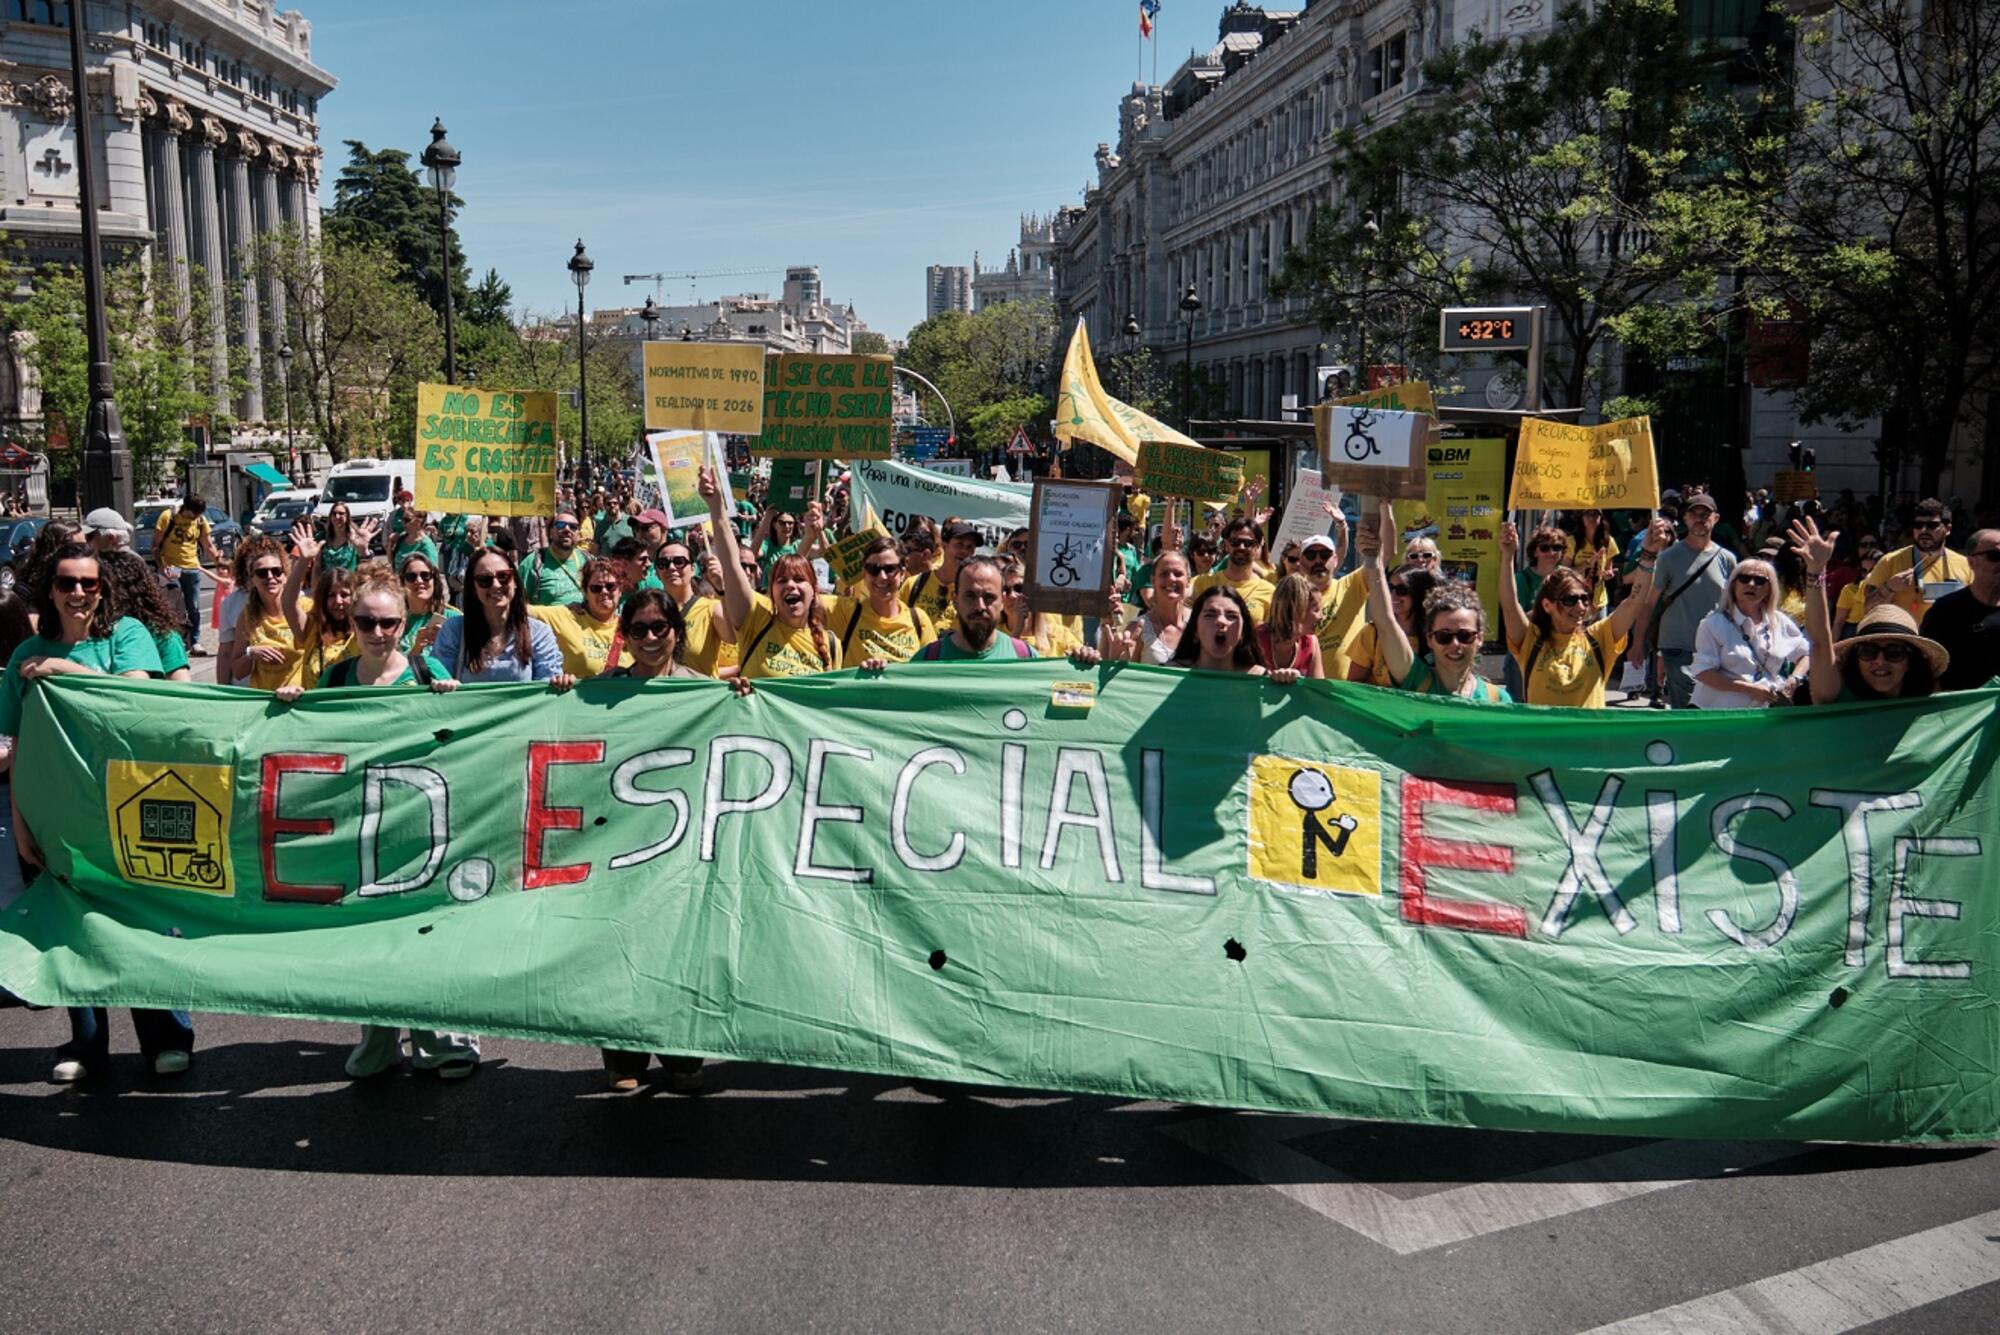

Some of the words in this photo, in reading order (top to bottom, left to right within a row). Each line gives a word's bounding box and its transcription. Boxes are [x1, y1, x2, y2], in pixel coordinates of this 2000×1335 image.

[1459, 320, 1512, 340] +32°C
[649, 366, 710, 380] NORMATIVA
[712, 368, 725, 380] DE
[785, 361, 812, 387] SE
[816, 362, 856, 387] CAE
[863, 363, 889, 387] EL
[442, 391, 480, 417] NO
[489, 394, 525, 419] ES
[655, 396, 704, 410] REALIDAD
[707, 398, 719, 410] DE
[723, 399, 754, 412] 2026
[421, 414, 554, 446] SOBRECARGA
[423, 444, 458, 471] ES
[465, 447, 554, 475] CROSSFIT
[1444, 448, 1470, 461] BM
[435, 475, 535, 503] LABORAL
[257, 750, 495, 906] ED.
